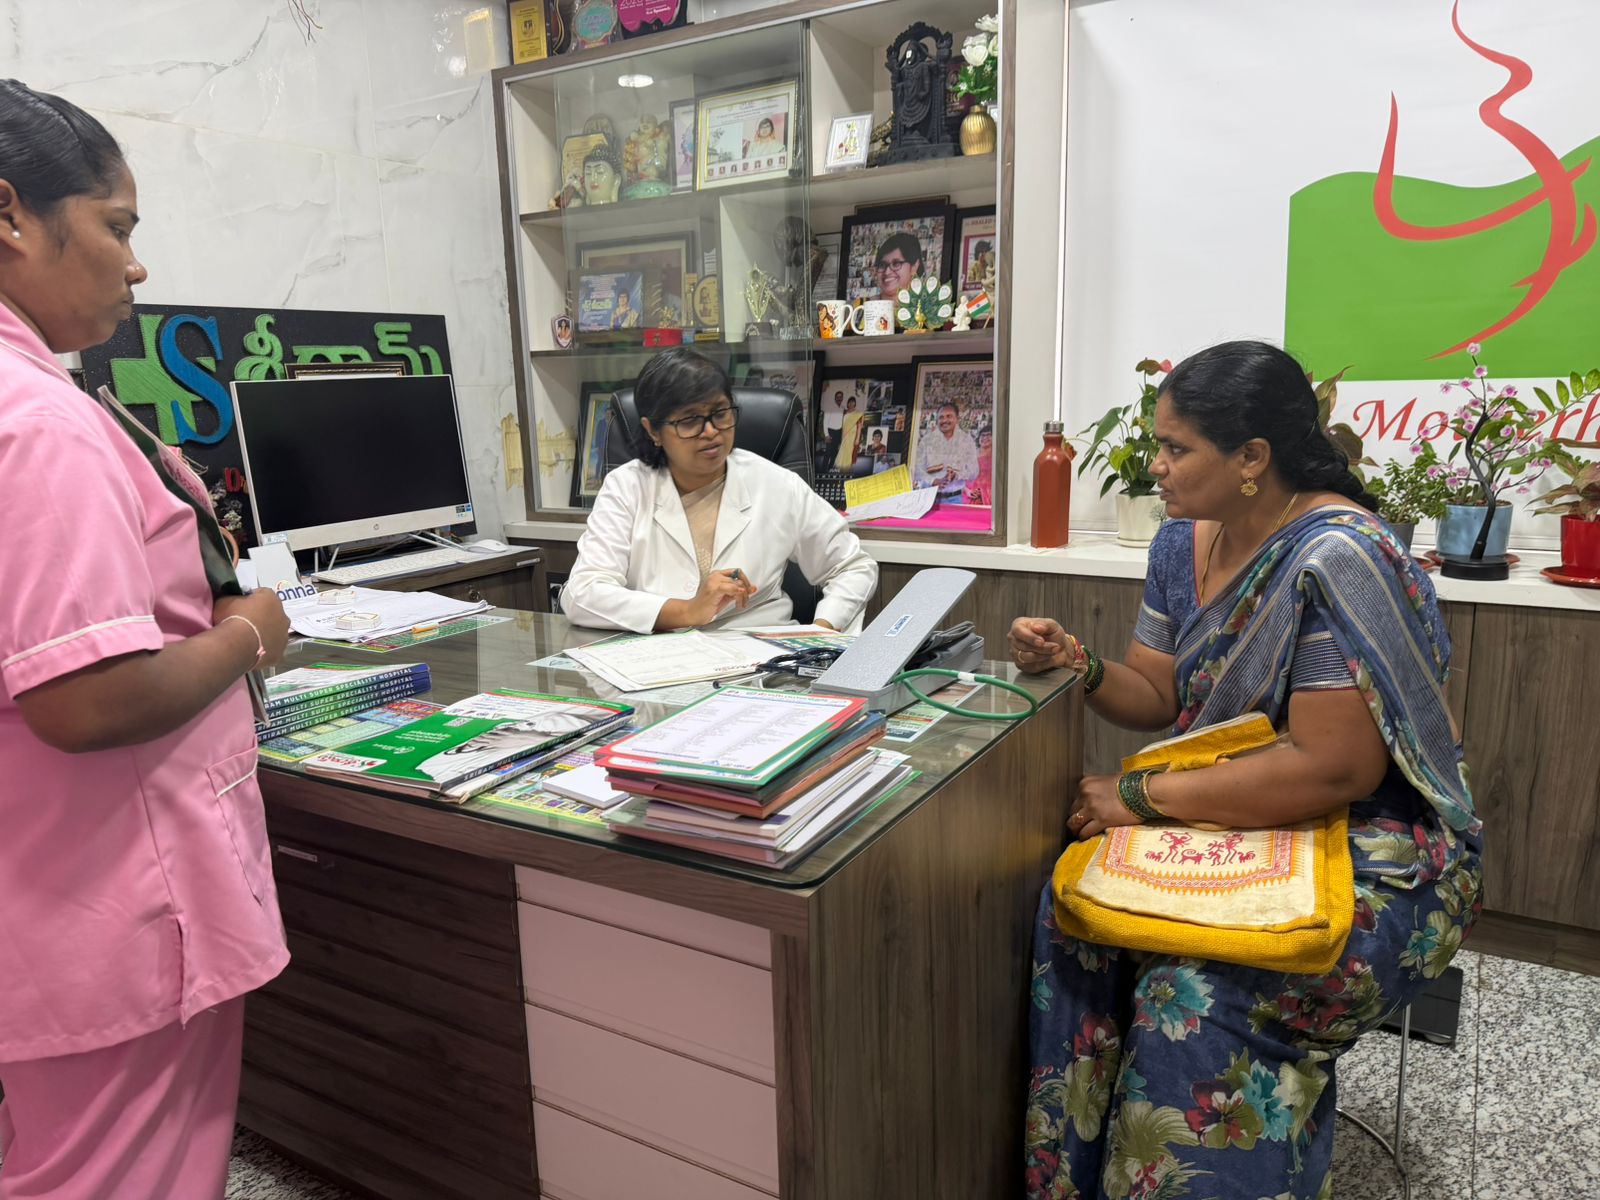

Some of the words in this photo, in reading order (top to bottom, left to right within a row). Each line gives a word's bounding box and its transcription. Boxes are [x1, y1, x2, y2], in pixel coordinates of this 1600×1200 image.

[283, 694, 307, 704] MULTI
[309, 687, 333, 698] SUPER
[335, 676, 377, 690] SPECIALITY
[379, 668, 412, 680] HOSPITAL
[284, 704, 307, 715] MULTI
[310, 695, 334, 707] SUPER
[337, 685, 378, 700] SPECIALITY
[381, 676, 413, 689] HOSPITAL
[286, 711, 309, 724] MULTI
[311, 704, 335, 716] SUPER
[338, 692, 379, 708] SPECIALITY
[381, 683, 414, 697] HOSPITAL
[290, 720, 313, 732] MULTI
[315, 712, 338, 725] SUPER
[340, 700, 381, 717] SPECIALITY
[383, 689, 415, 703] HOSPITAL
